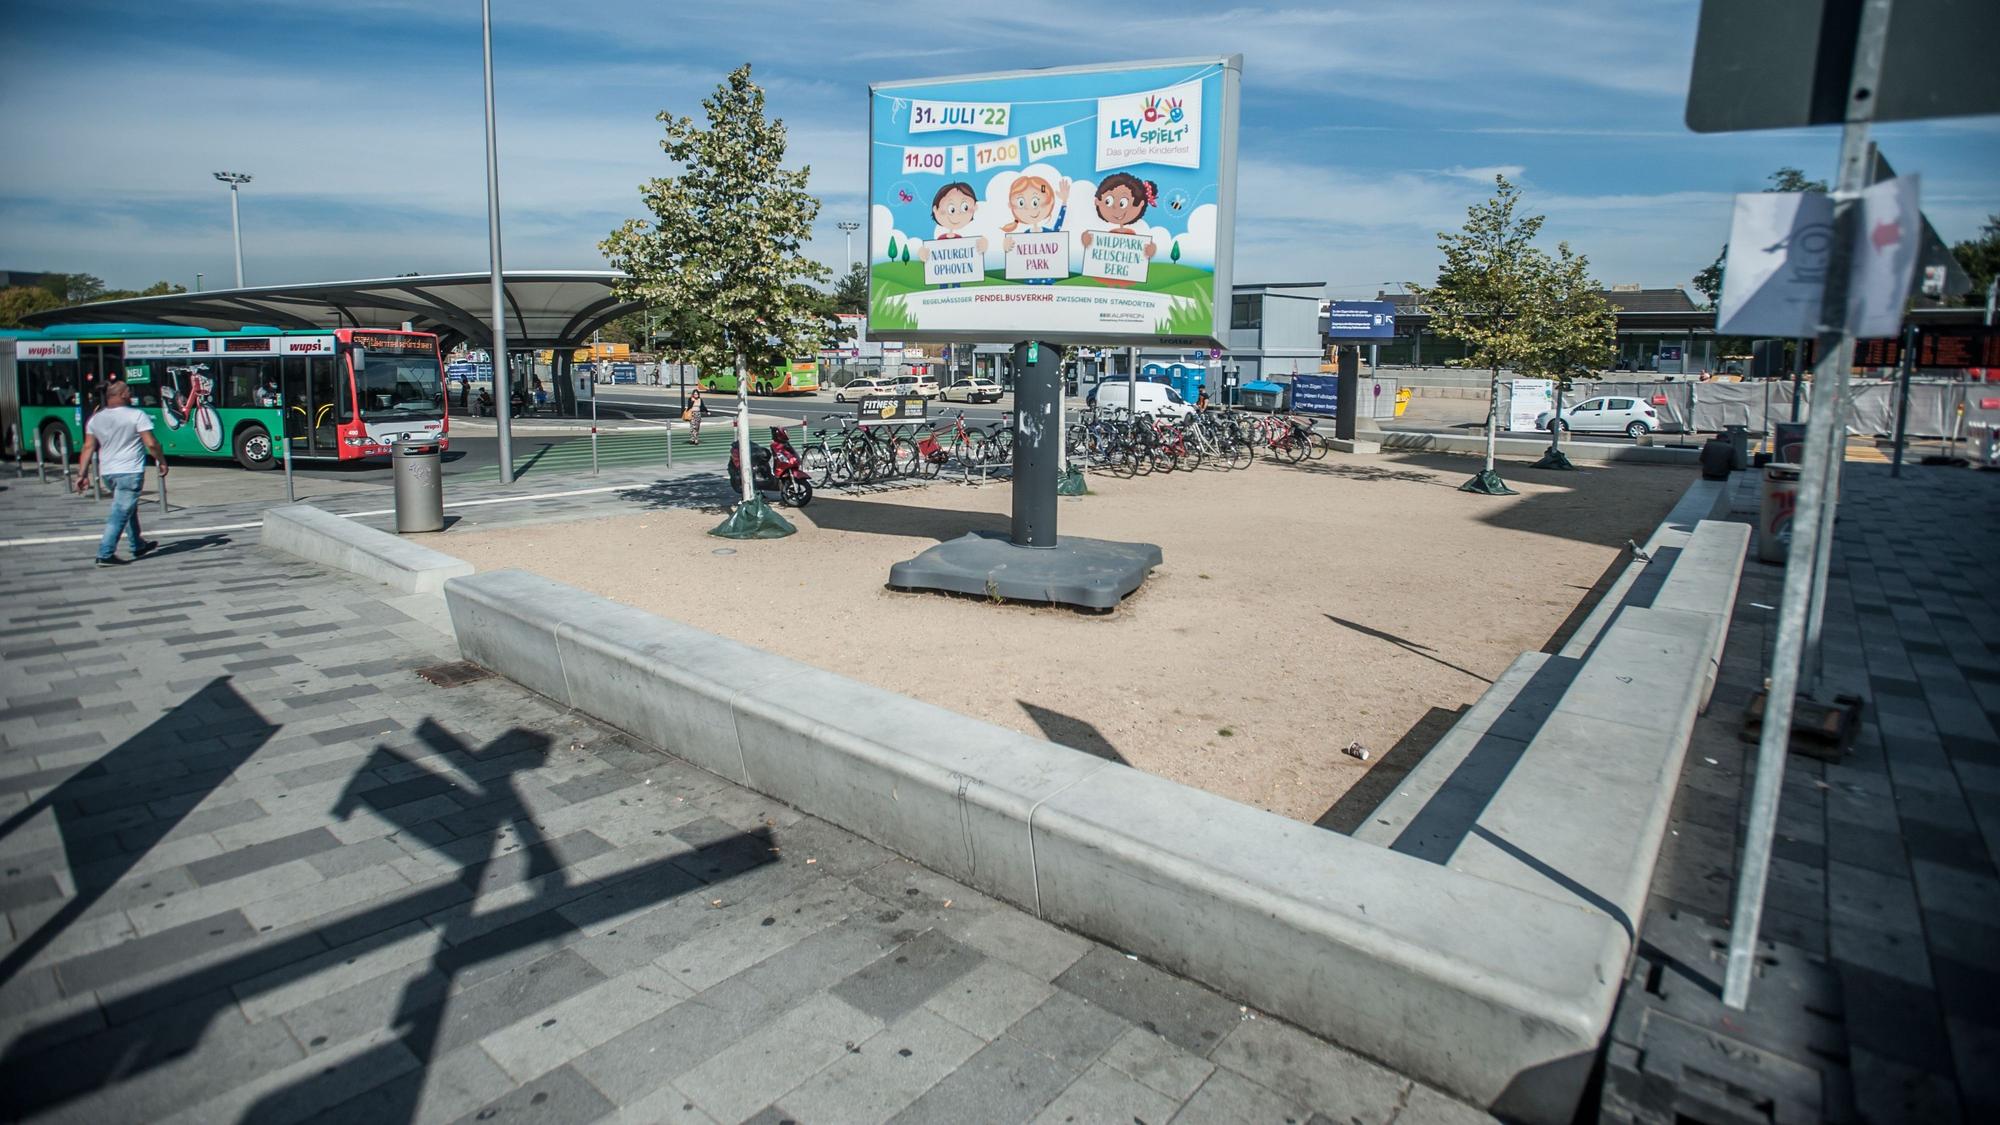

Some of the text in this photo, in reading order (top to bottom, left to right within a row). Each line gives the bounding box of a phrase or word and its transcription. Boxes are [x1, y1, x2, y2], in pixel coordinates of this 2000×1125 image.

[915, 107, 936, 124] 31.
[940, 107, 975, 125] JULI
[1110, 118, 1143, 139] LEV
[905, 153, 944, 168] 11.00
[977, 144, 1018, 164] 17.00
[1030, 133, 1063, 154] UHR
[1106, 146, 1189, 157] Das große Kinderfest
[1016, 242, 1059, 255] NEULAND
[1096, 235, 1143, 251] WILDPARK
[931, 247, 975, 261] NATURGUT
[934, 263, 974, 276] OPHOVEN
[1026, 259, 1050, 270] PARK
[1104, 263, 1129, 276] BERG
[922, 296, 973, 305] REGELMÄSSIGER
[1056, 295, 1092, 304] ZWISCHEN
[1094, 297, 1108, 305] DEN
[1110, 298, 1156, 308] STANDORTEN
[289, 338, 321, 354] wupsi
[127, 368, 143, 378] NEU
[863, 400, 899, 409] FITNESS
